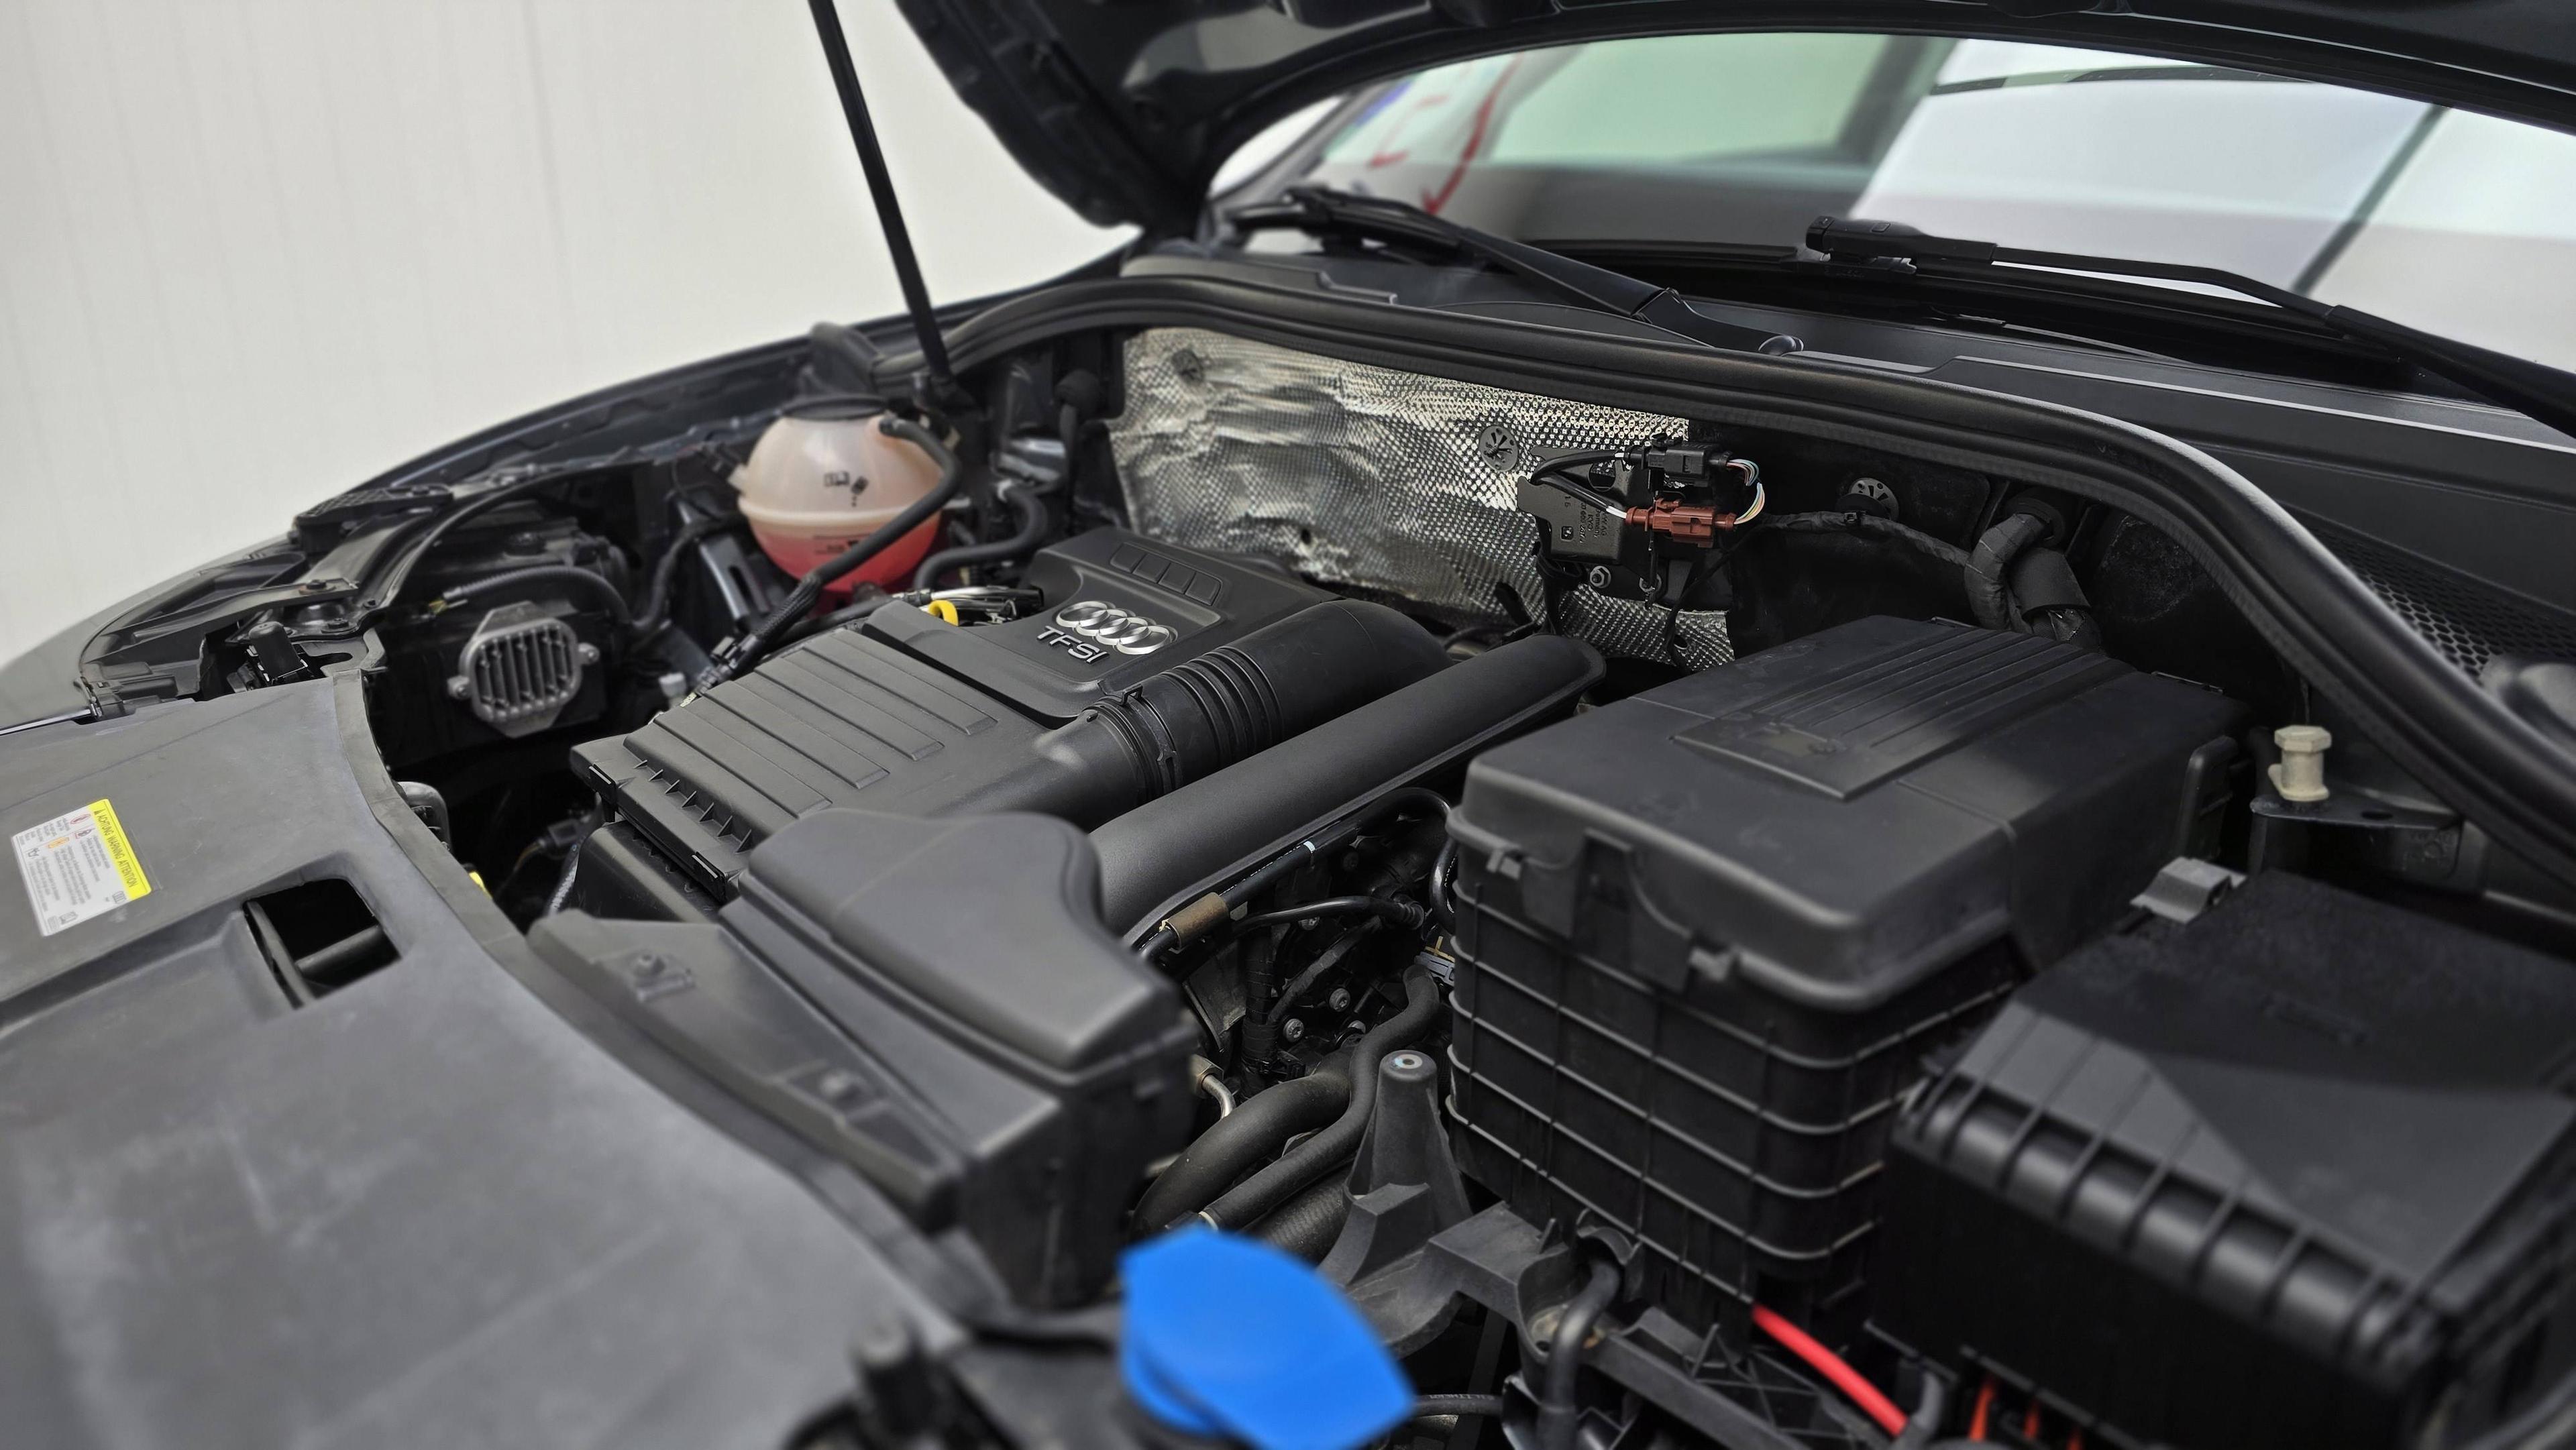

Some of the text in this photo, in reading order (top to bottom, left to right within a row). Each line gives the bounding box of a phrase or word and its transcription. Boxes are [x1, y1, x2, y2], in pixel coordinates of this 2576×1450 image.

[1037, 625, 1108, 663] TFSI
[98, 815, 138, 888] ACHTUNG WARNING ATTENTION
